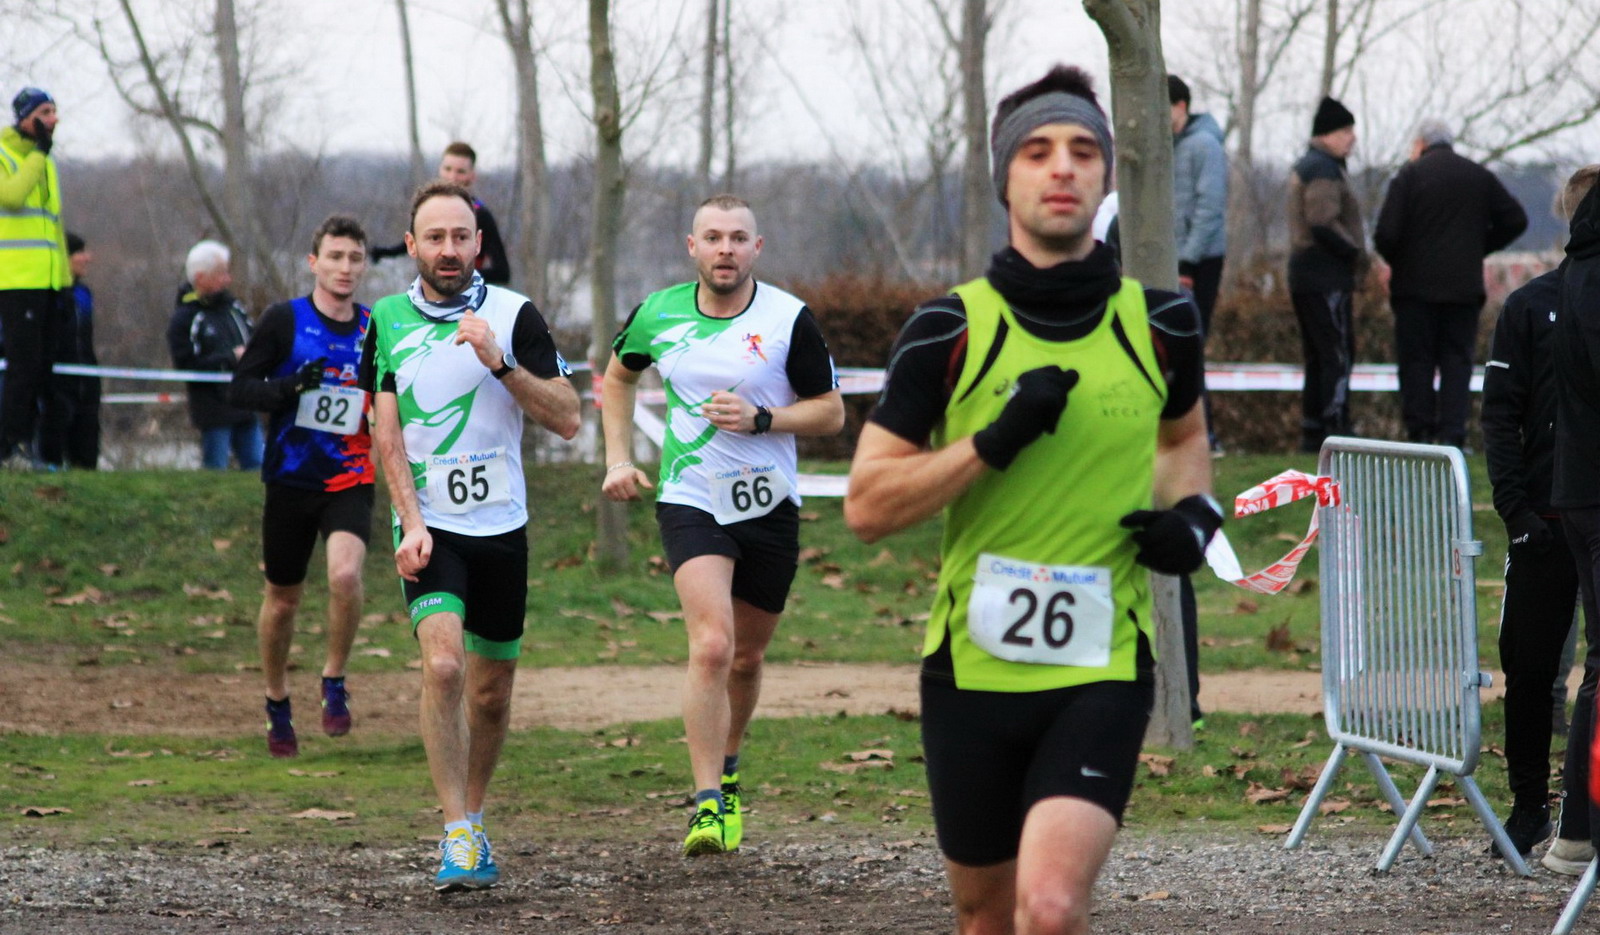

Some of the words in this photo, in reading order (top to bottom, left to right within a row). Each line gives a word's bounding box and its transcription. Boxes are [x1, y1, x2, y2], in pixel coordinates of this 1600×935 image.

[314, 395, 349, 426] 82
[433, 457, 458, 465] Crédit
[469, 451, 497, 463] Mutuel
[447, 464, 489, 505] 65
[715, 470, 741, 480] Crédit
[731, 475, 773, 512] 66
[990, 560, 1033, 581] Crédit
[1052, 570, 1098, 584] Mutuel
[418, 597, 443, 609] TEAM
[1001, 587, 1076, 649] 26
